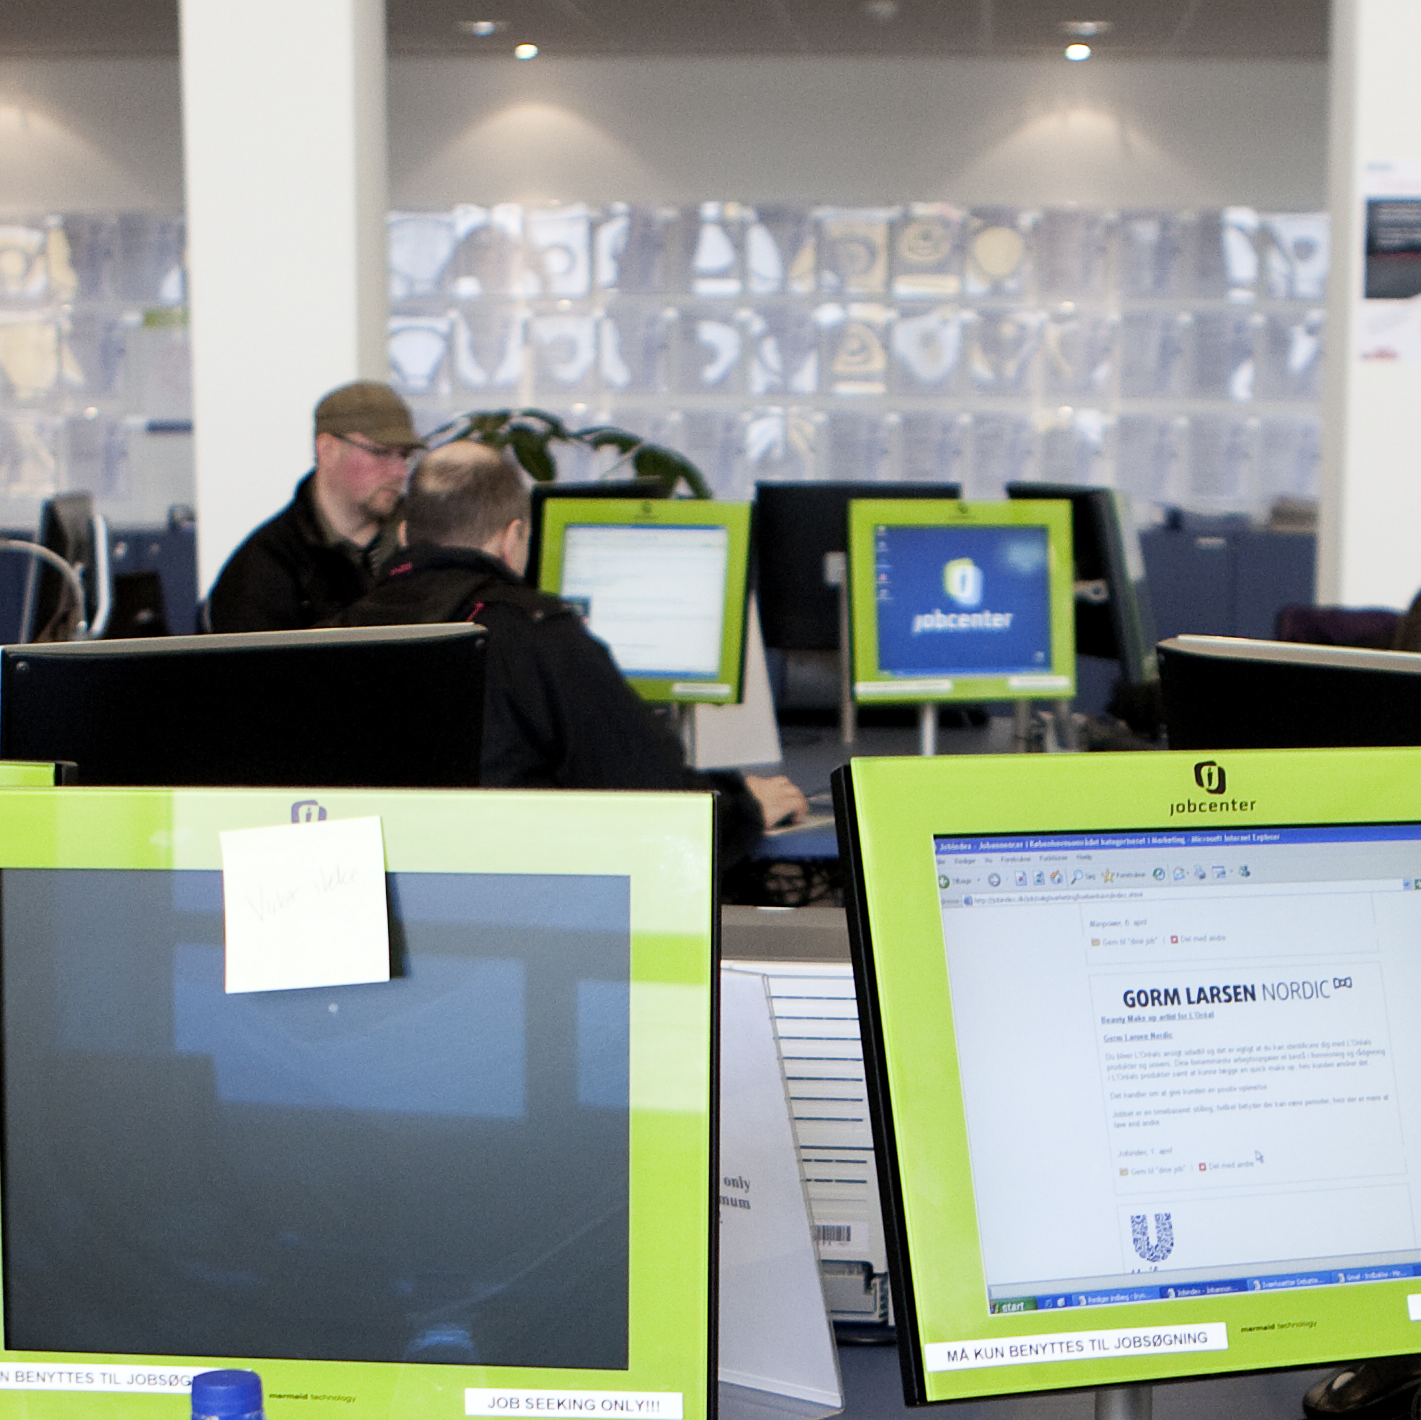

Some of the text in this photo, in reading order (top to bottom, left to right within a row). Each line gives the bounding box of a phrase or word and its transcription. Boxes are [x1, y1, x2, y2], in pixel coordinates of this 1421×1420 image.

[913, 609, 1013, 635] jobcenter
[1169, 797, 1257, 817] jobcenter
[1123, 980, 1331, 1008] GORM LARSEN NORDIC
[724, 1176, 750, 1193] only
[1002, 1302, 1025, 1312] start
[947, 1332, 1208, 1363] MÅ KUN BENYTTES TIL JOBSØGNING
[15, 1371, 94, 1385] BENYTTES
[100, 1373, 122, 1385] TIL
[127, 1374, 192, 1386] JOBSØG
[269, 1392, 308, 1401] mermaid
[487, 1396, 661, 1413] JOB SEEKING ONLY!!!
